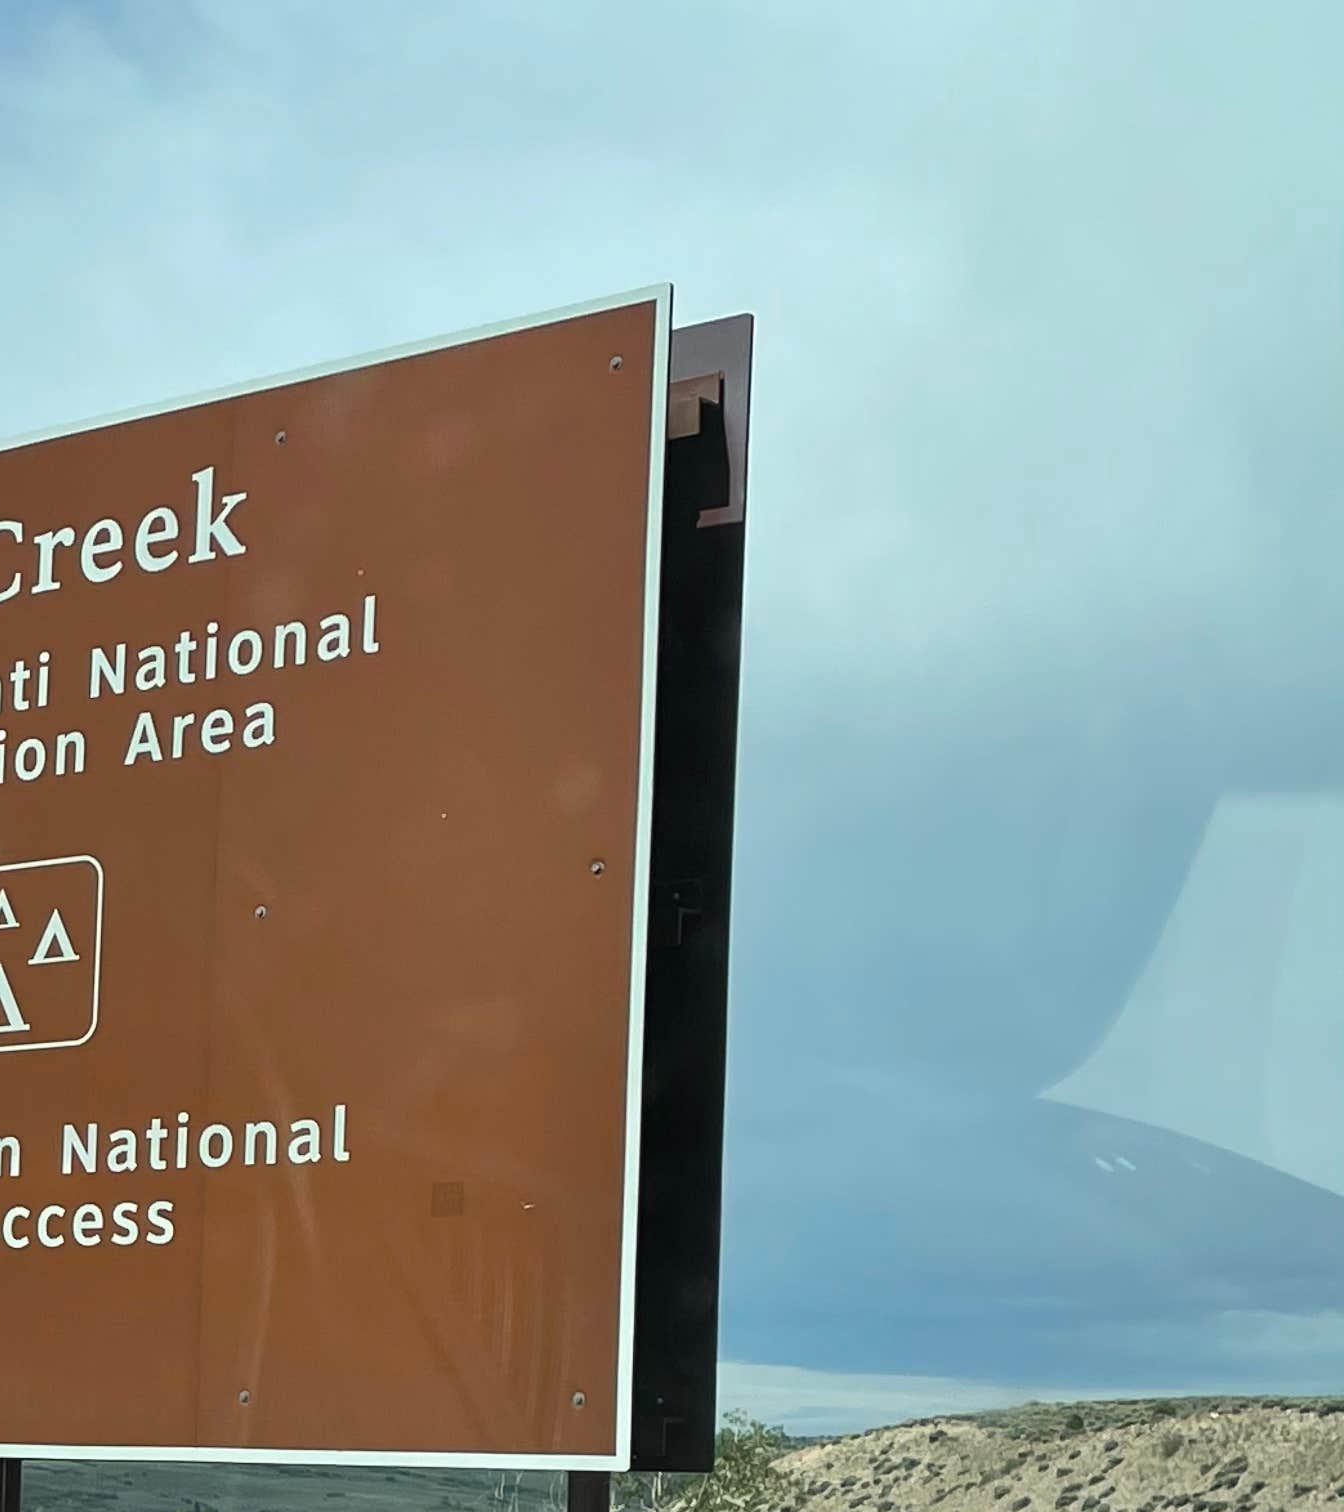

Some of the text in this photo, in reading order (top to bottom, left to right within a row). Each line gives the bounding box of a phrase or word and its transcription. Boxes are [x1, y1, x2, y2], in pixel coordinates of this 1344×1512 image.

[89, 596, 379, 699] National
[123, 702, 275, 766] Area
[61, 1104, 350, 1175] National
